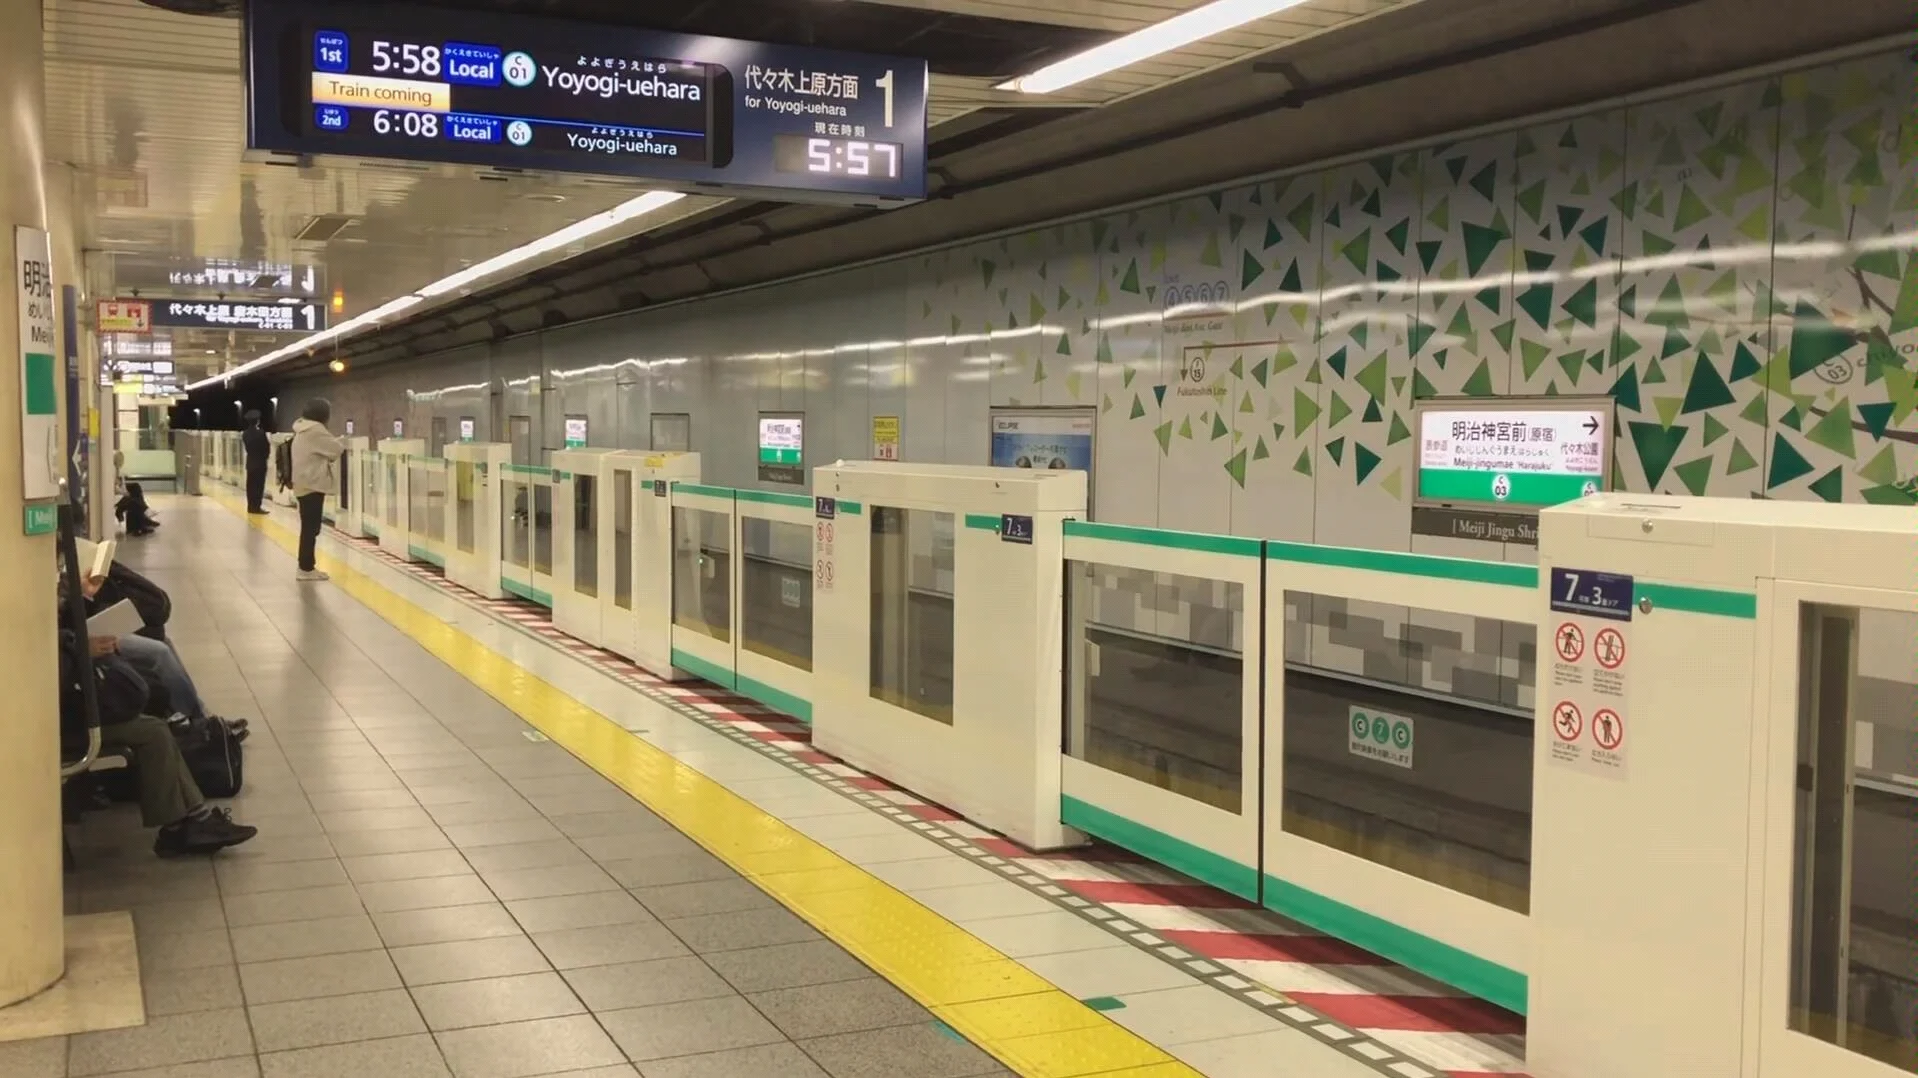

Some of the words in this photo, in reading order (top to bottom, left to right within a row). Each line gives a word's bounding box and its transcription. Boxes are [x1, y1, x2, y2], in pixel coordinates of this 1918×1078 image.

[320, 47, 342, 62] 1st
[373, 41, 441, 76] 5:58
[515, 56, 522, 65] C
[577, 55, 667, 73] よよぎうえはら
[449, 59, 494, 79] Local
[509, 67, 527, 79] 01
[542, 65, 700, 100] Yoyogi-uehara
[744, 64, 859, 100] 代々木上原方面
[329, 81, 370, 98] Train
[374, 88, 432, 107] coming
[875, 69, 894, 128] 1
[744, 95, 761, 108] for
[765, 97, 847, 116] Yoyogi-uehara
[322, 114, 342, 126] 2nd
[373, 110, 438, 137] 6:08
[814, 122, 865, 137] 現在時刻
[454, 124, 491, 140] Local
[512, 131, 525, 140] 01
[591, 127, 654, 139] よよぎうえはら
[567, 133, 677, 155] Yoyogi-uehara
[808, 138, 896, 177] 5:57
[301, 305, 315, 330] 1
[1828, 366, 1847, 379] 03
[1452, 421, 1526, 442] 明治神宮前
[1560, 442, 1598, 456] 代々木公園
[1453, 457, 1514, 469] Meiji-jingumae
[1495, 486, 1506, 496] 03
[1007, 517, 1012, 535] 7
[1460, 519, 1484, 537] Meiji
[1487, 522, 1514, 541] Jingu
[1565, 573, 1579, 601] 7
[1592, 586, 1602, 605] 3
